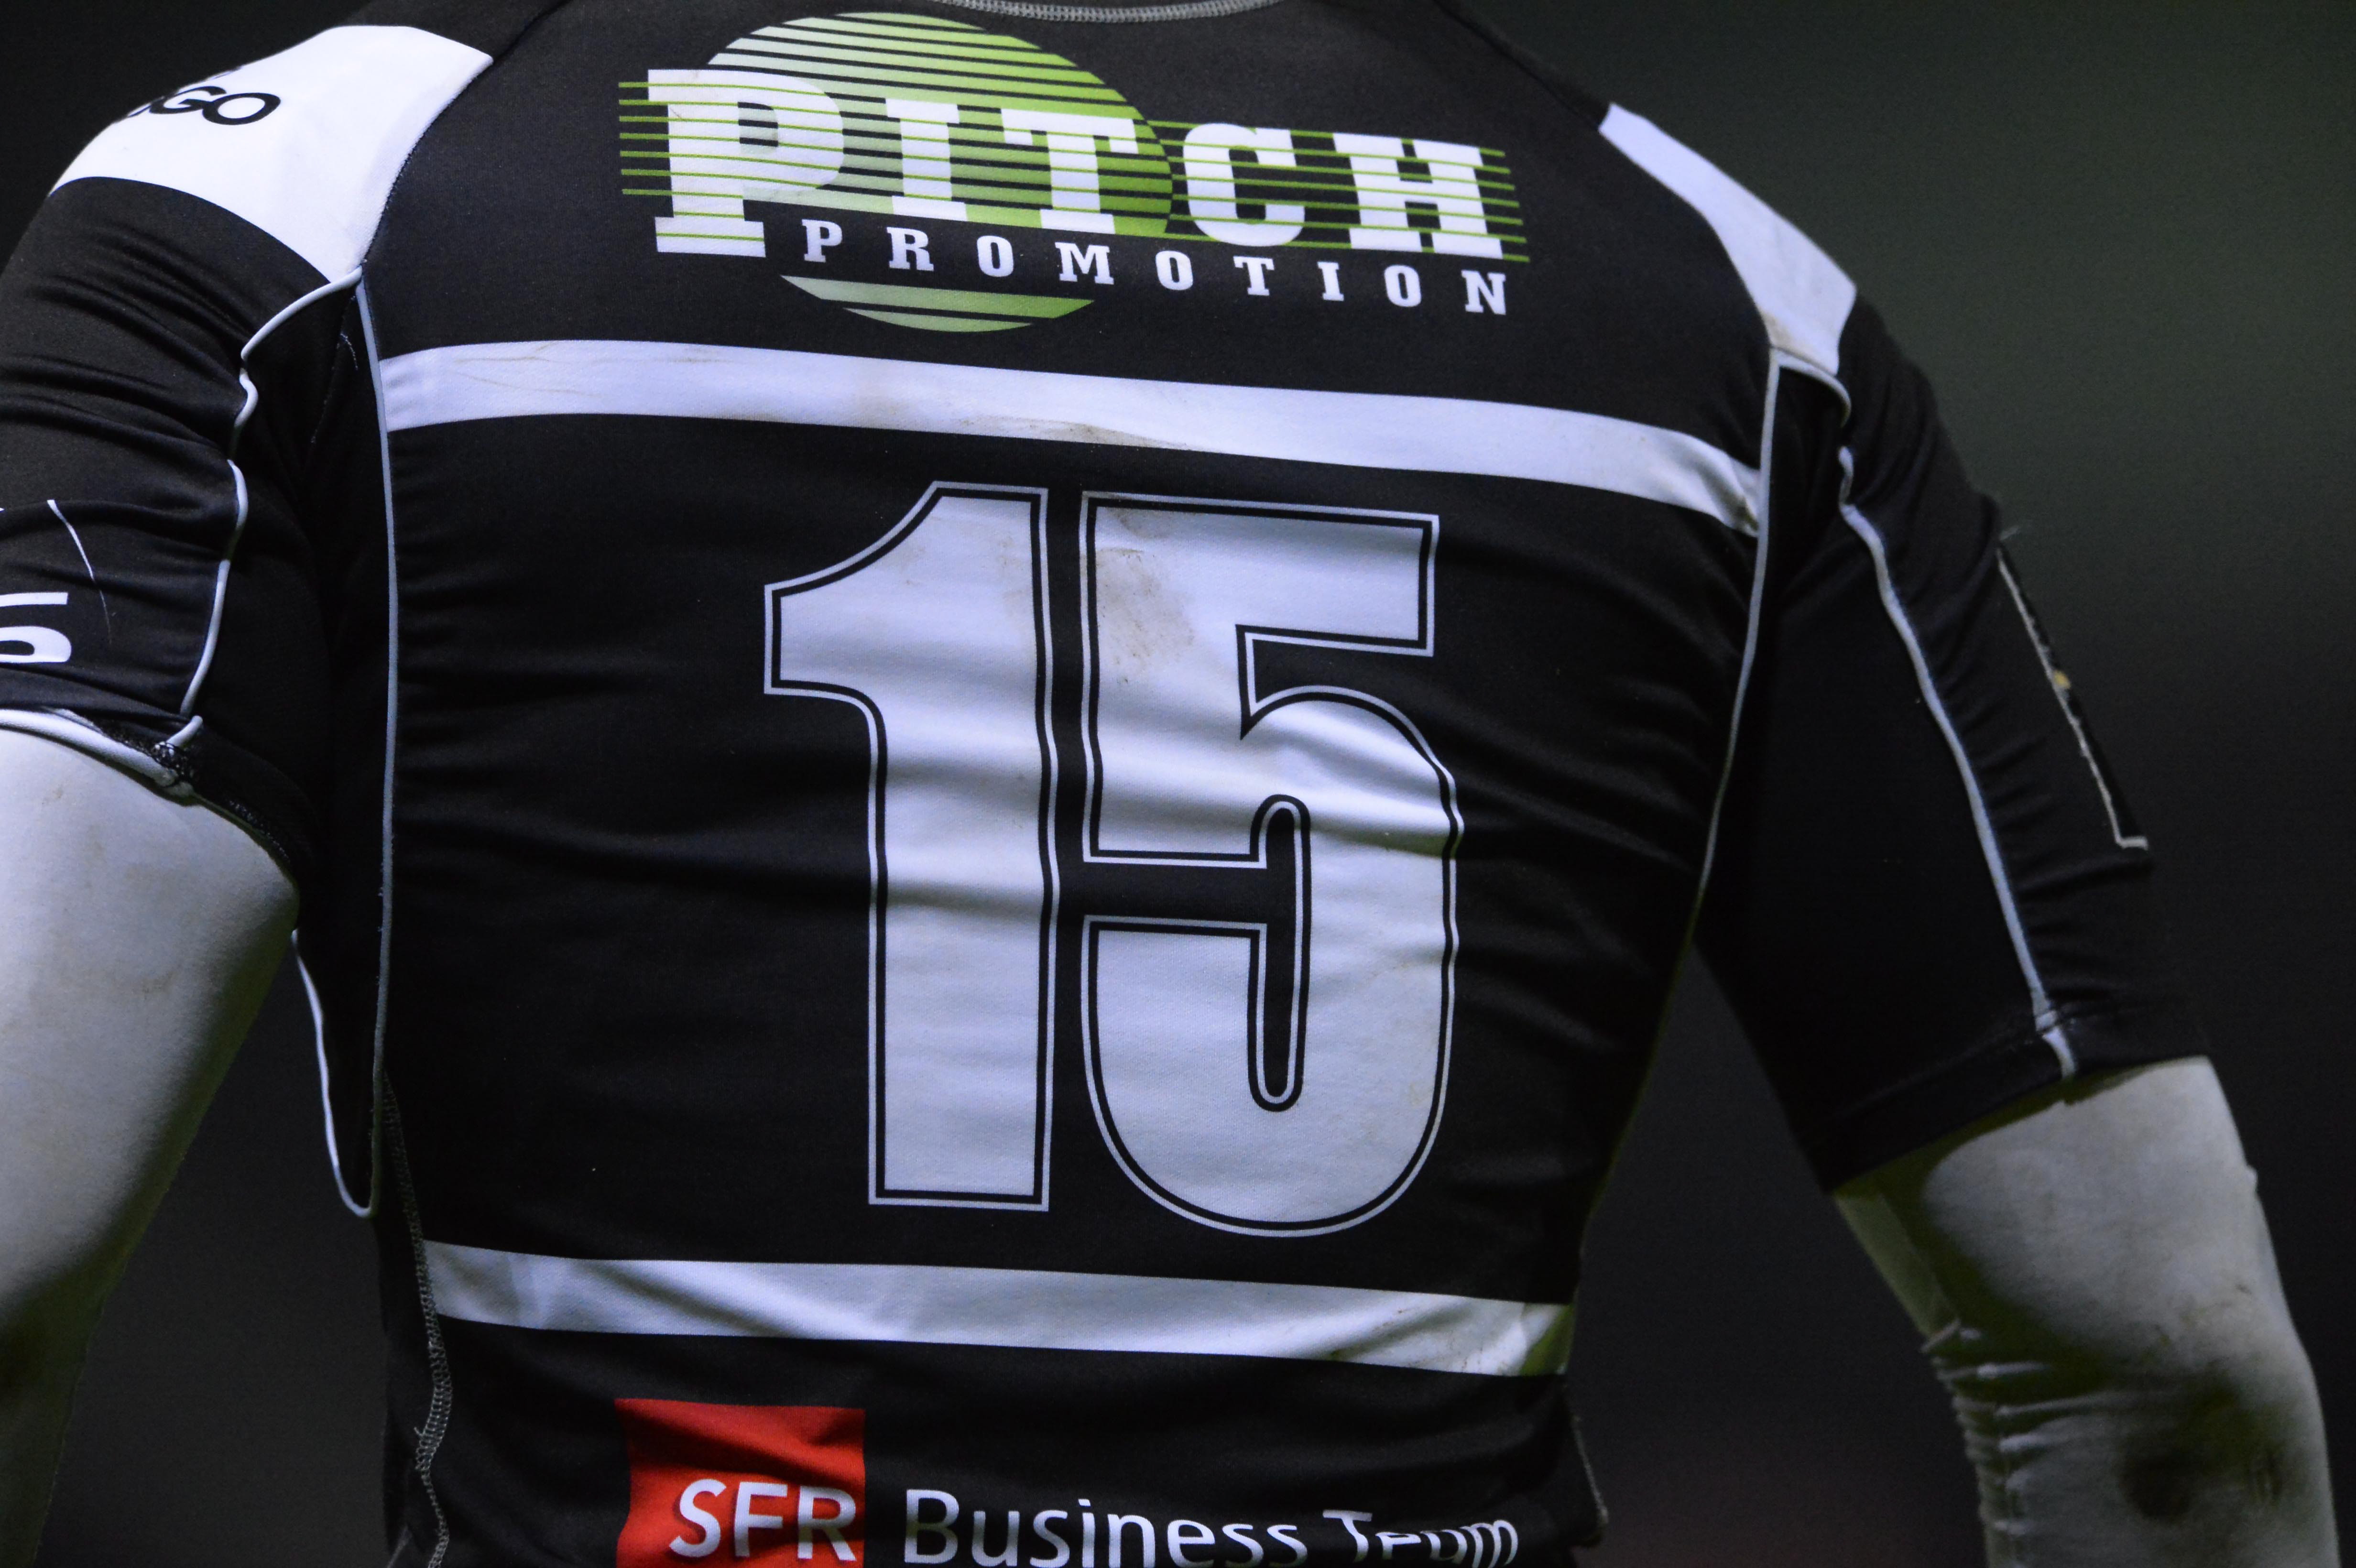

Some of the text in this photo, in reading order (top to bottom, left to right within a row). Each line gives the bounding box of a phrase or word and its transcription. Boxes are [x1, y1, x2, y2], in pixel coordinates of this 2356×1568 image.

[128, 86, 281, 125] GO
[648, 69, 1503, 259] PITCH
[801, 218, 1507, 316] PROMOTION
[764, 480, 1464, 1237] 15
[669, 1478, 857, 1561] SFR
[904, 1489, 1308, 1568] Business
